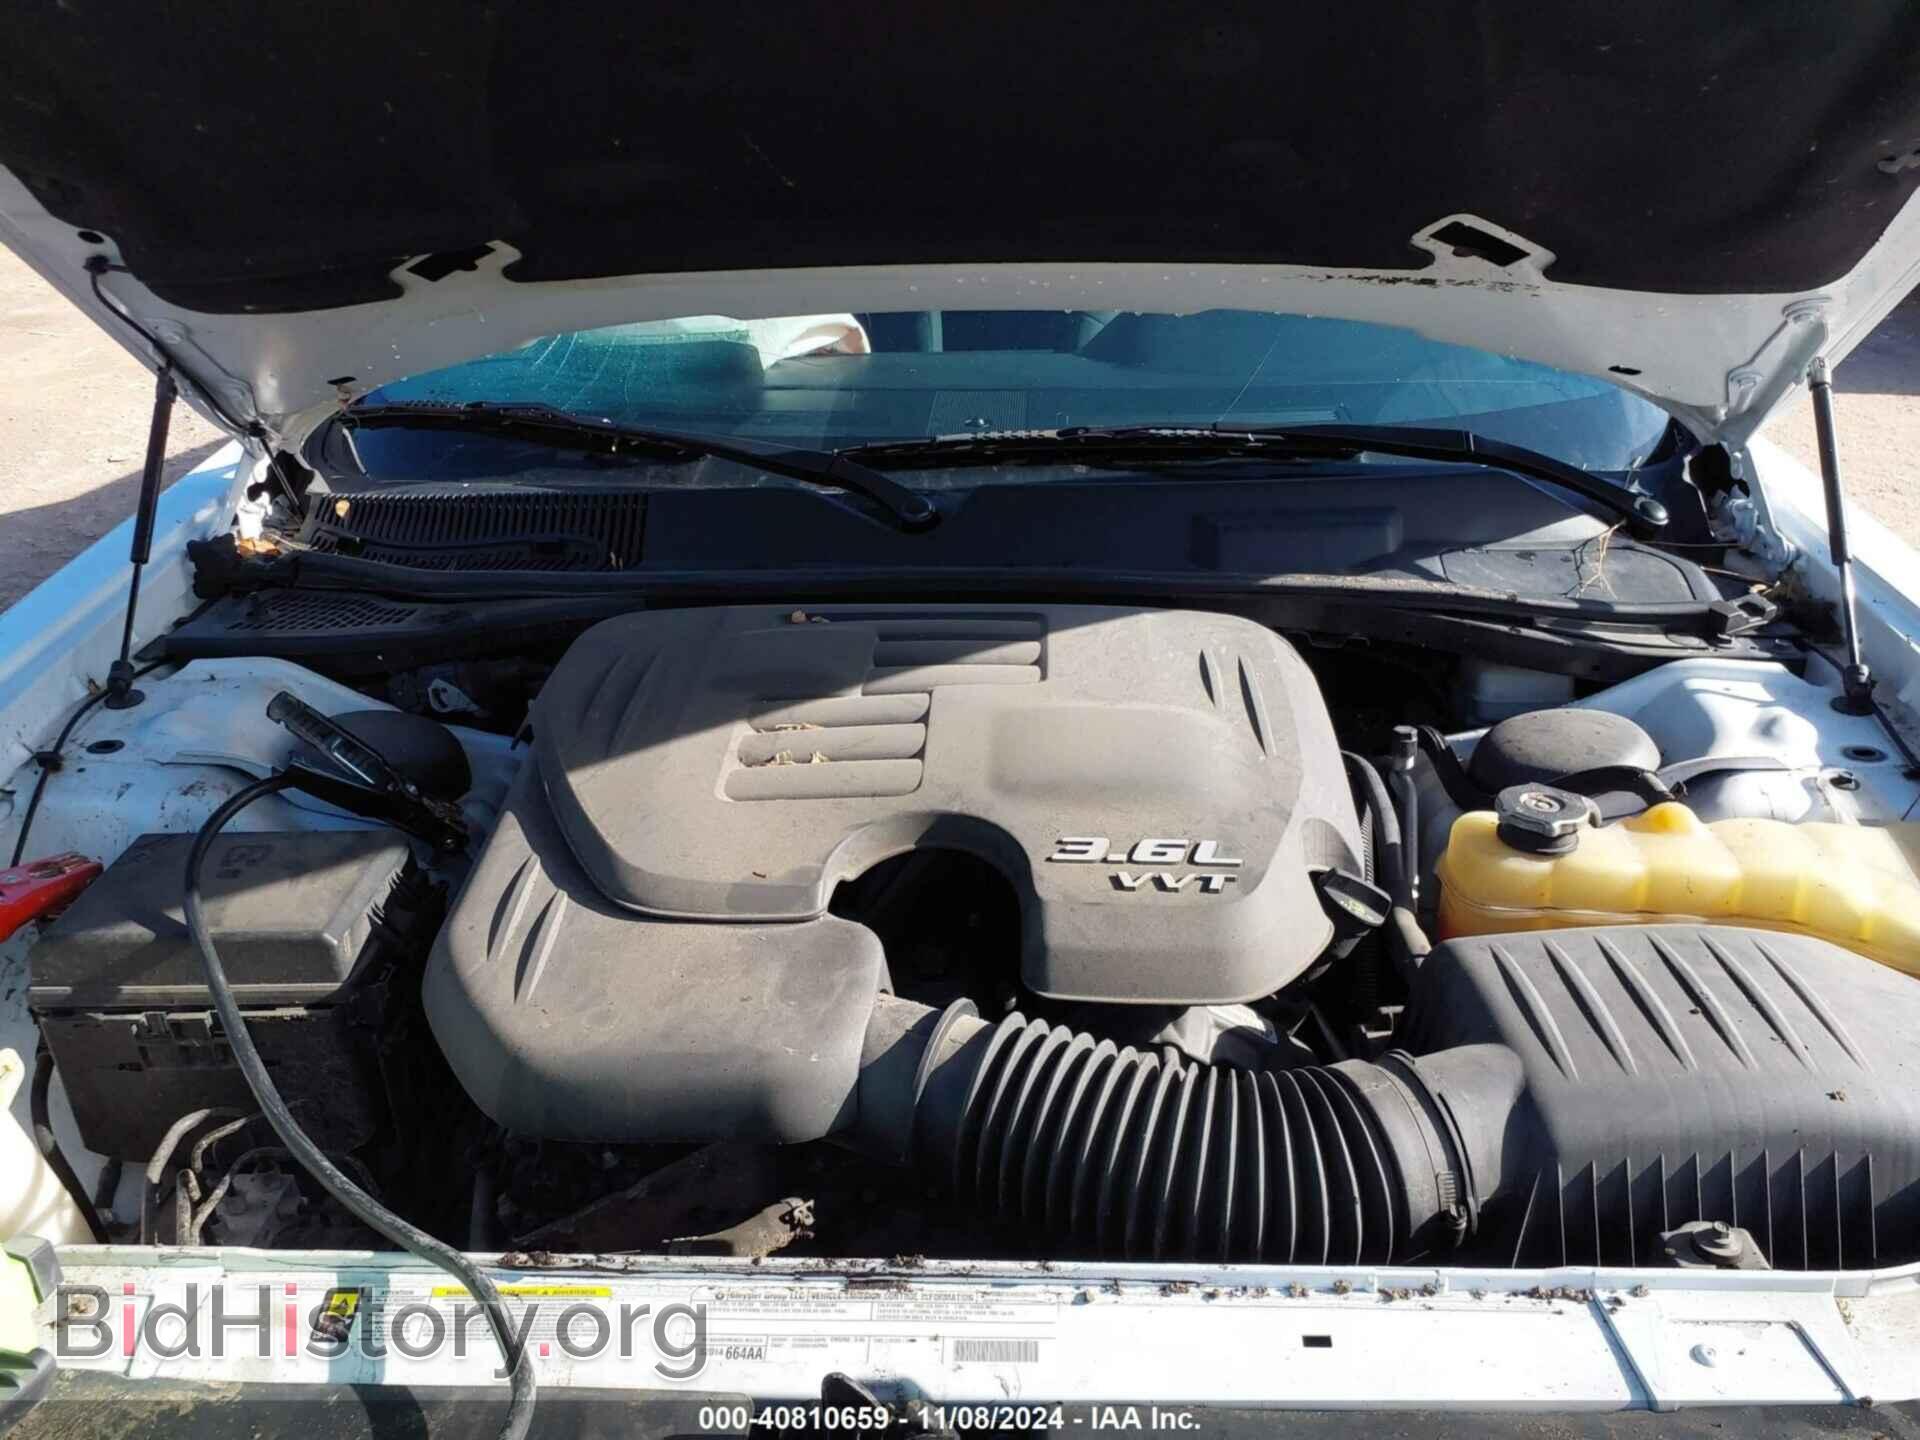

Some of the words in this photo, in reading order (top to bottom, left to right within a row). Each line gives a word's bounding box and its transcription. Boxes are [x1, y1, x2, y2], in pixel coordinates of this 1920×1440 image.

[1047, 837, 1243, 867] 3.6L
[1108, 871, 1236, 894] VVT
[725, 1345, 763, 1360] 664AA
